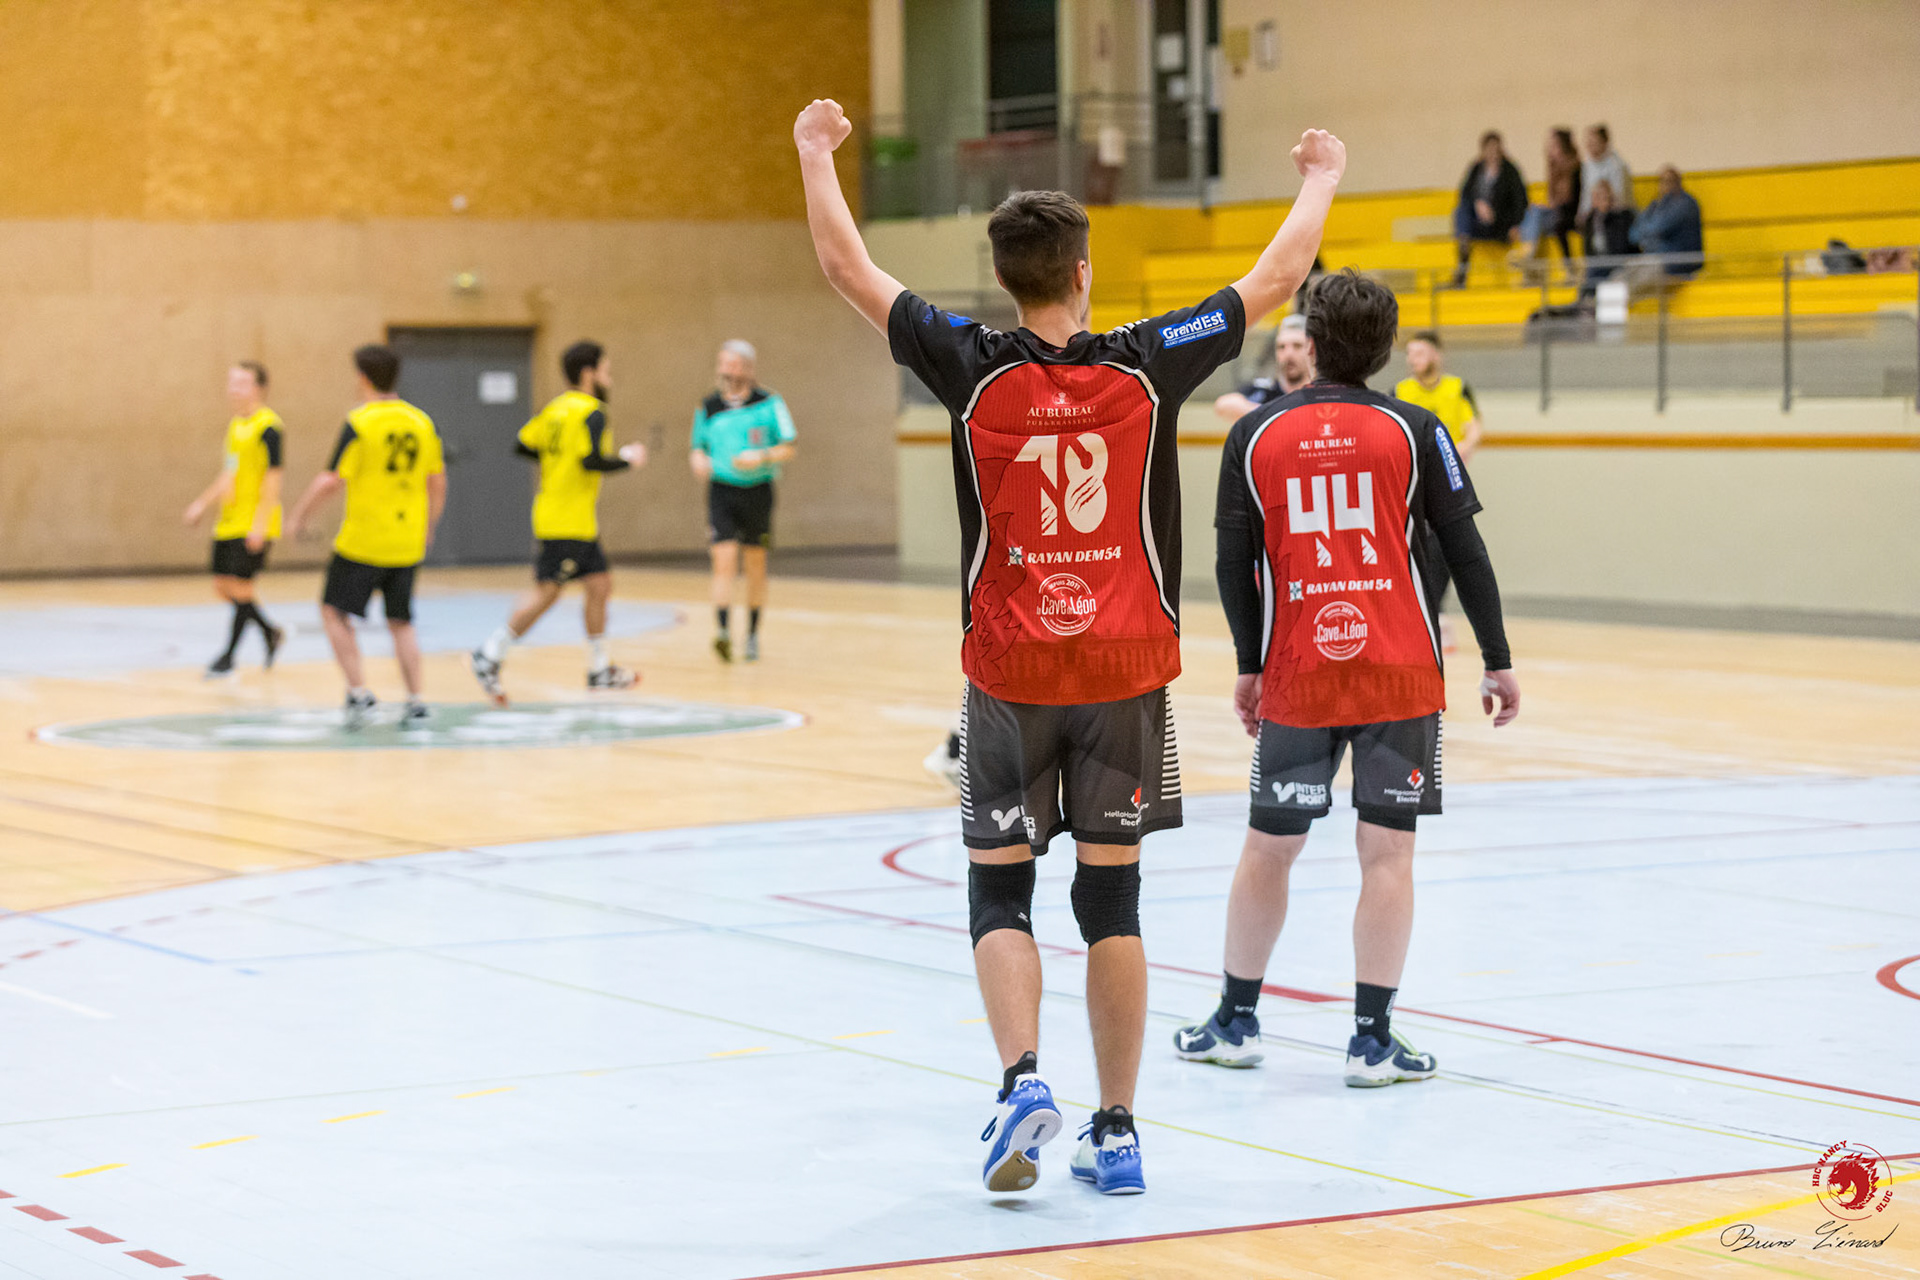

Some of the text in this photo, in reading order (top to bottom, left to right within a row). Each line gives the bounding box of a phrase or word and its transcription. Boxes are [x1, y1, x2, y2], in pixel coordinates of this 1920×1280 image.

[1027, 404, 1096, 418] AU BUREAU
[386, 431, 419, 473] 29
[1299, 437, 1356, 450] AU BUREAU
[1014, 432, 1109, 536] 18
[1286, 471, 1378, 568] 44
[1027, 551, 1073, 564] RAYAN
[1066, 579, 1081, 591] 2011
[1306, 580, 1346, 595] RAYAN
[1042, 594, 1067, 616] Cave
[1070, 595, 1097, 615] Léon
[1316, 623, 1339, 643] Cave
[1344, 620, 1368, 640] Léon
